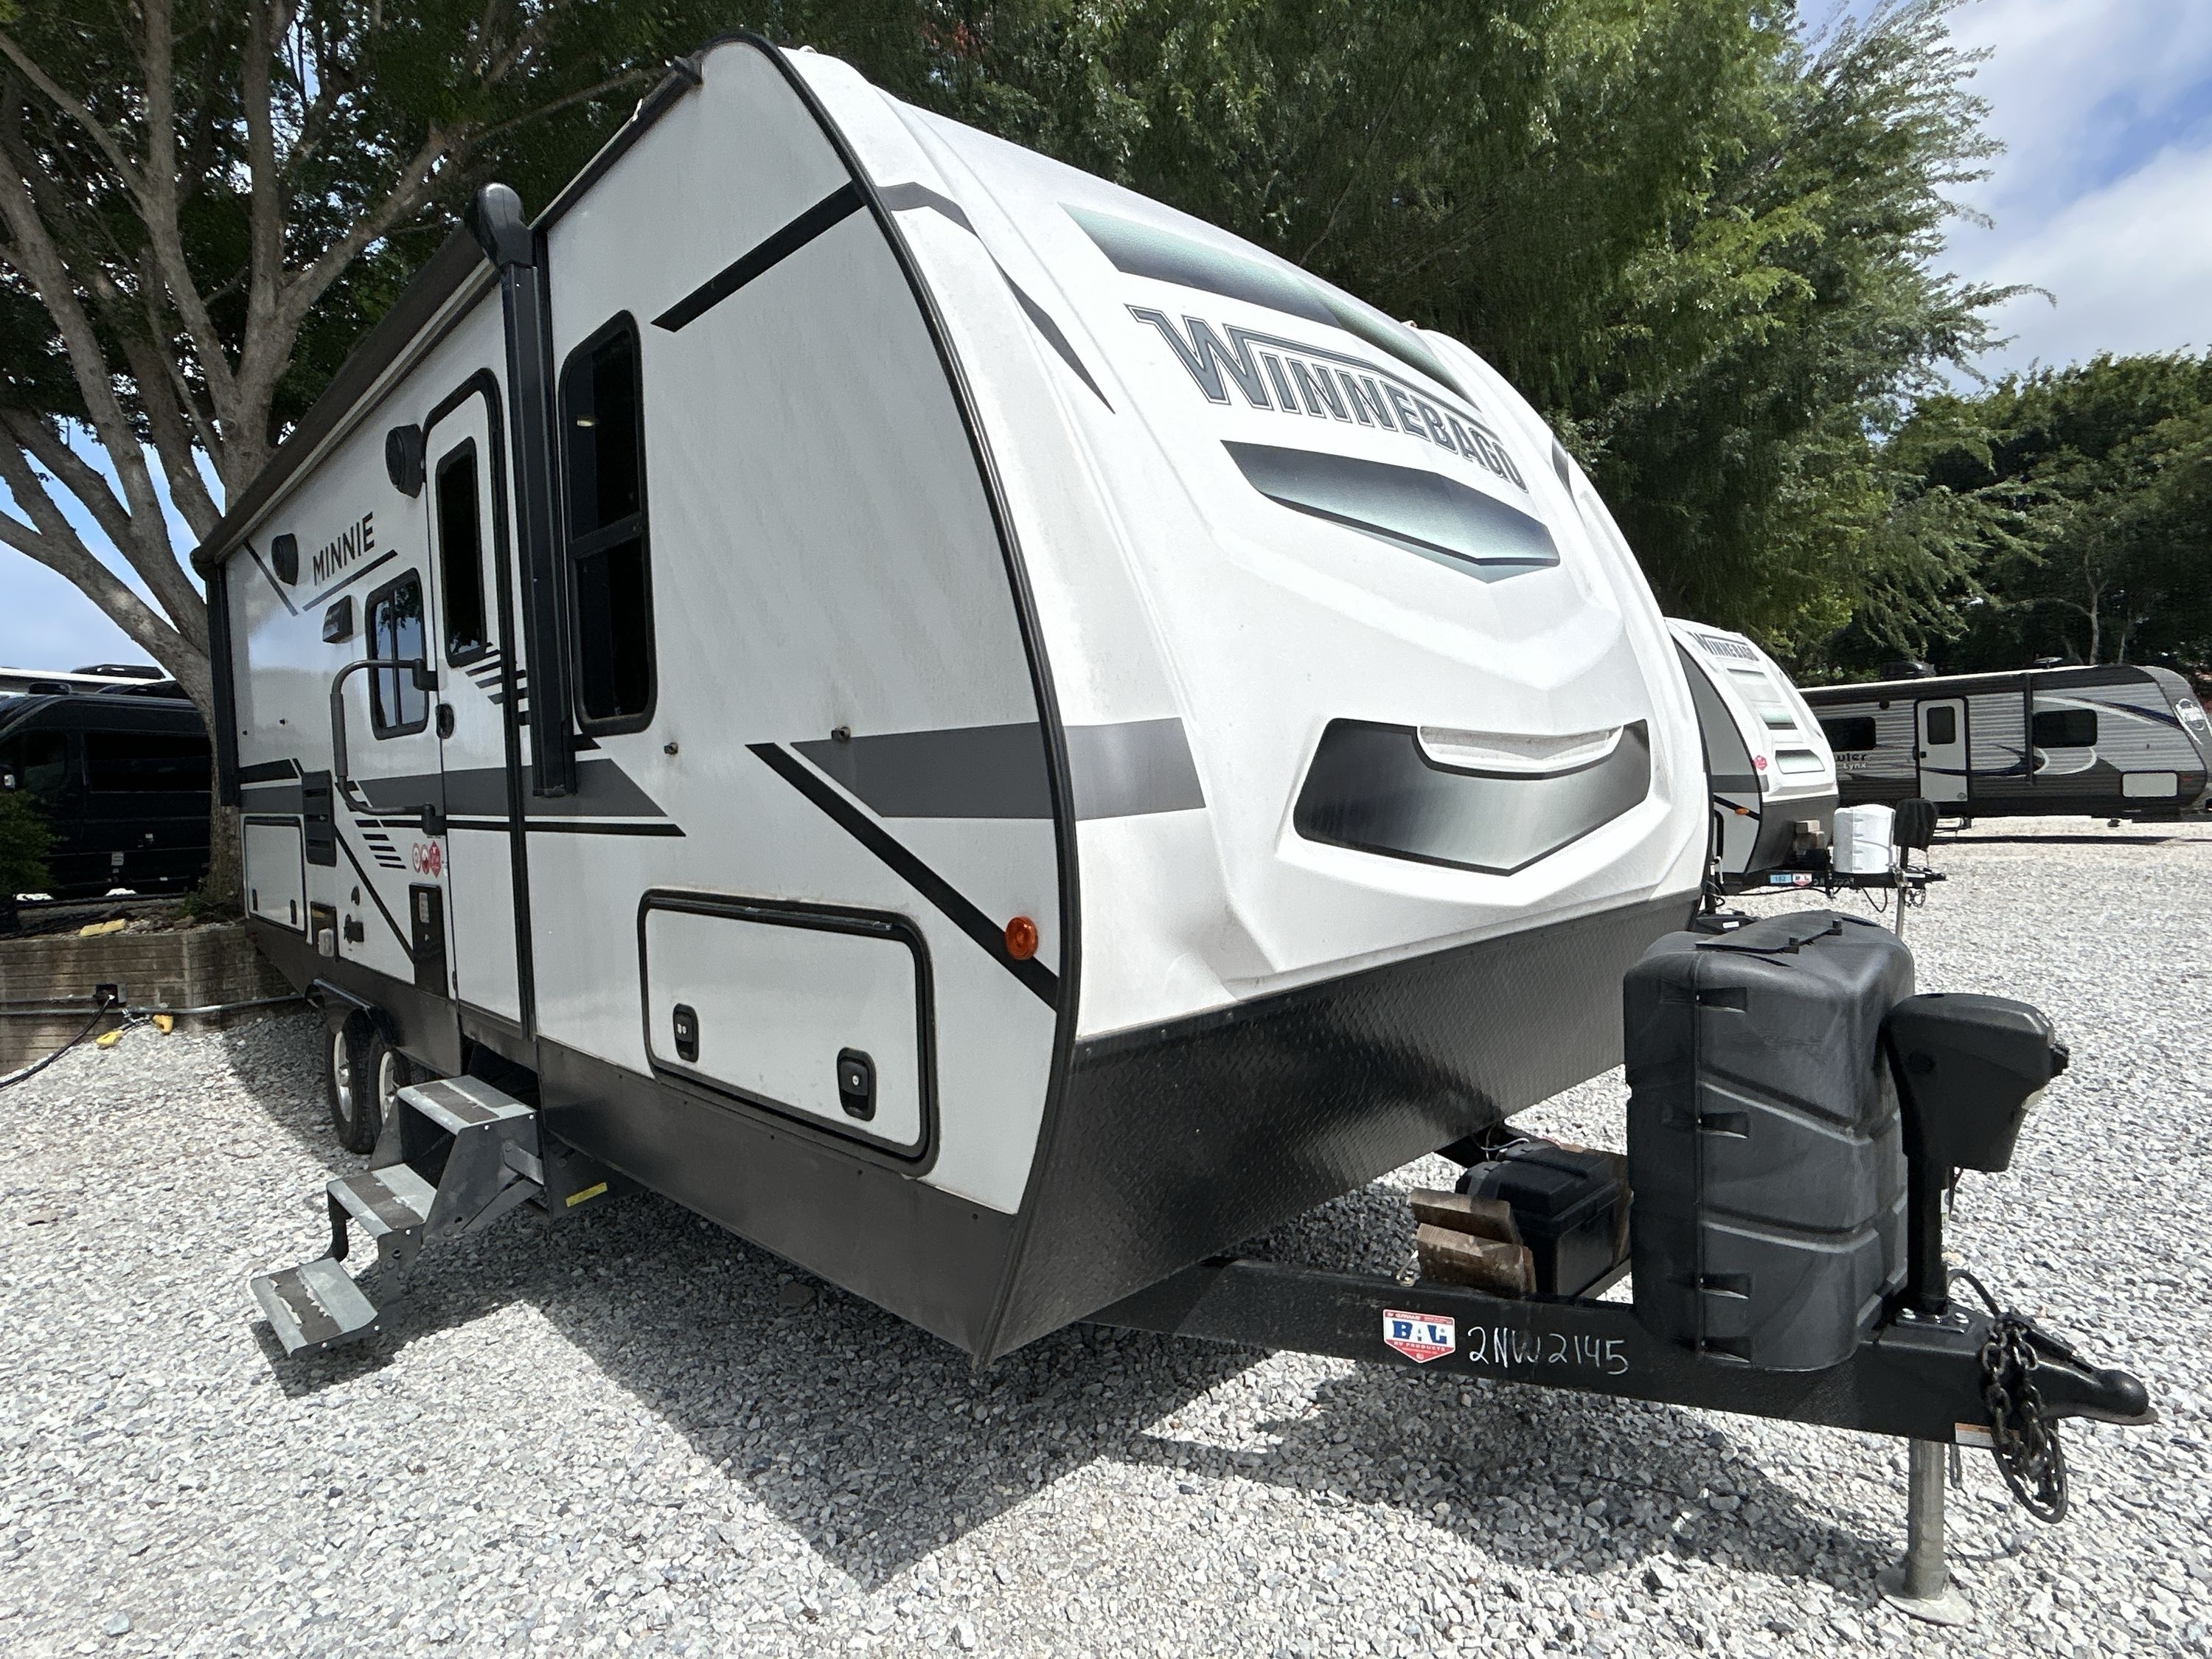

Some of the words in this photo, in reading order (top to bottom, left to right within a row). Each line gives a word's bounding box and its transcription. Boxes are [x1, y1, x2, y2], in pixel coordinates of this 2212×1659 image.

[1123, 303, 1529, 493] WINNEBAGO
[313, 511, 375, 586] MINNIE
[1686, 631, 1760, 661] WINNEBAGO
[1392, 1320, 1447, 1345] BAL
[1405, 1343, 1446, 1352] PRODUCTS
[1467, 1326, 1630, 1376] 2NW2145
